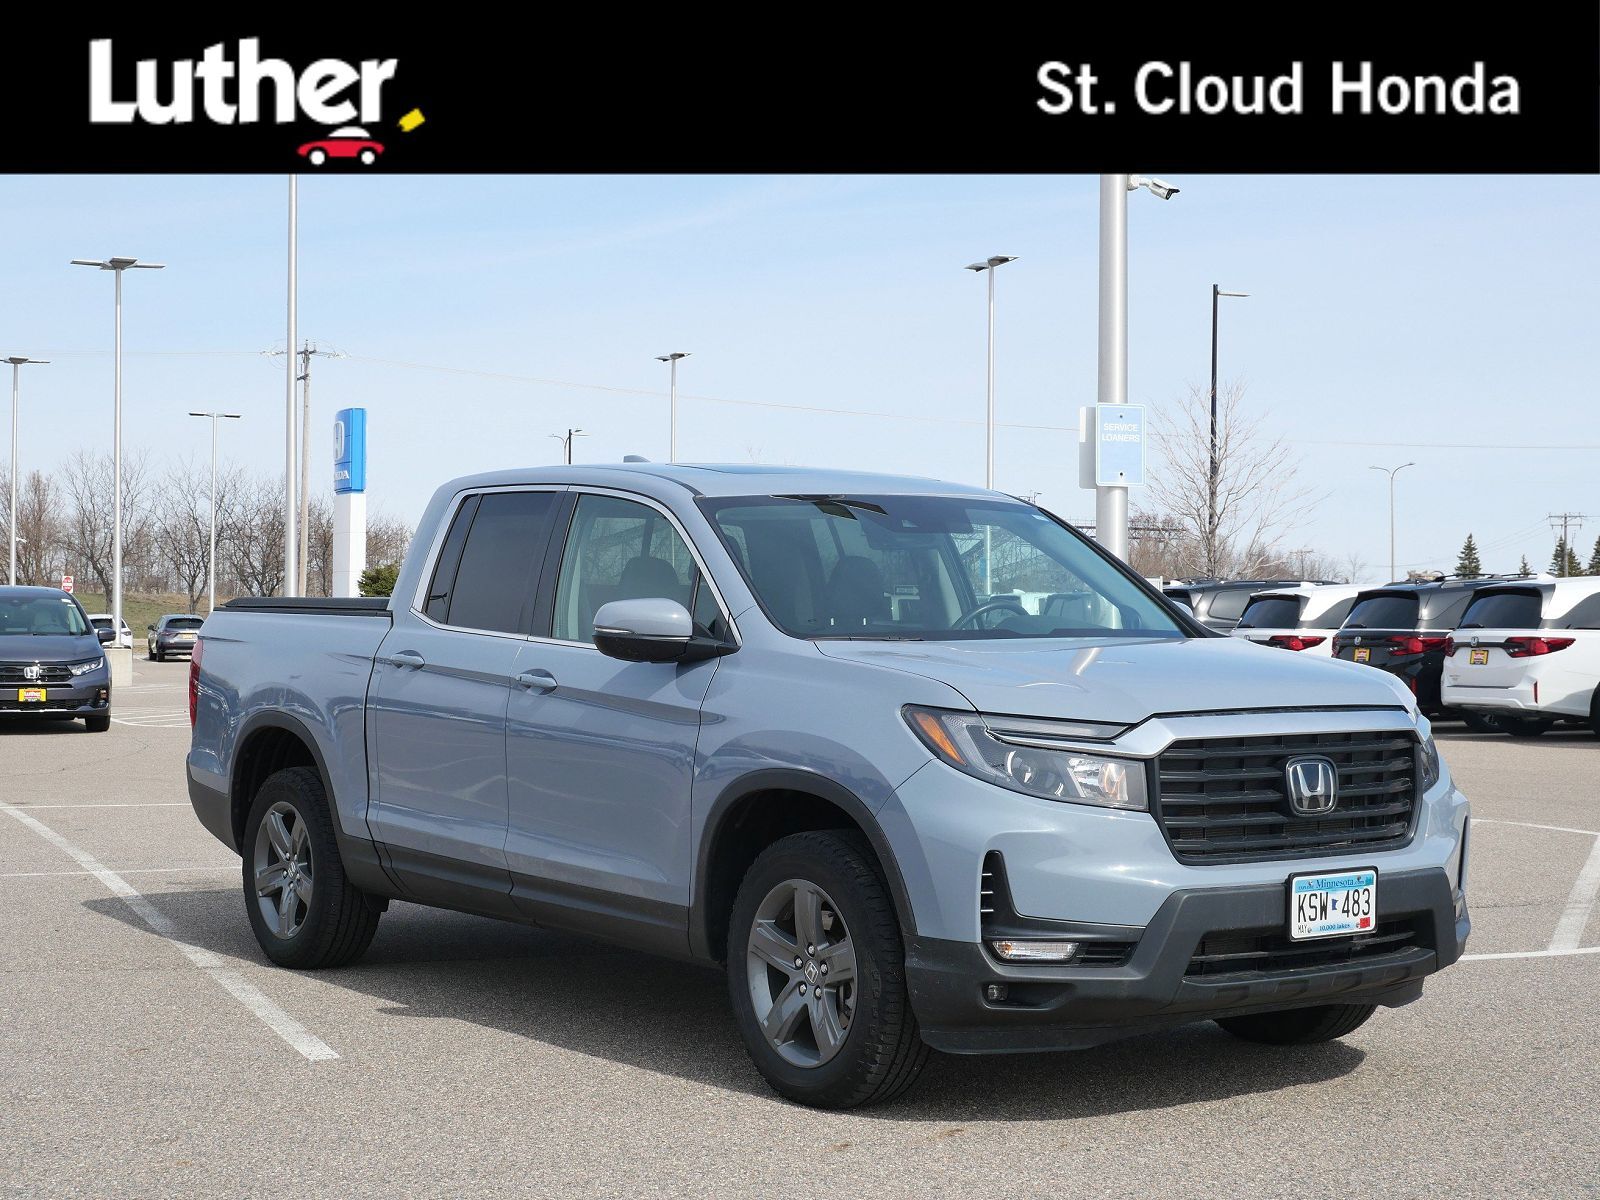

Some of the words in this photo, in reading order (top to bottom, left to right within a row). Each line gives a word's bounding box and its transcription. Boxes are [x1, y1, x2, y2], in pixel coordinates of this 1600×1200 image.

[1103, 423, 1138, 432] SERVICE
[1102, 433, 1139, 441] LOANERS
[1316, 879, 1354, 888] Minnesota
[1297, 891, 1329, 923] KSW
[1342, 888, 1371, 918] 483
